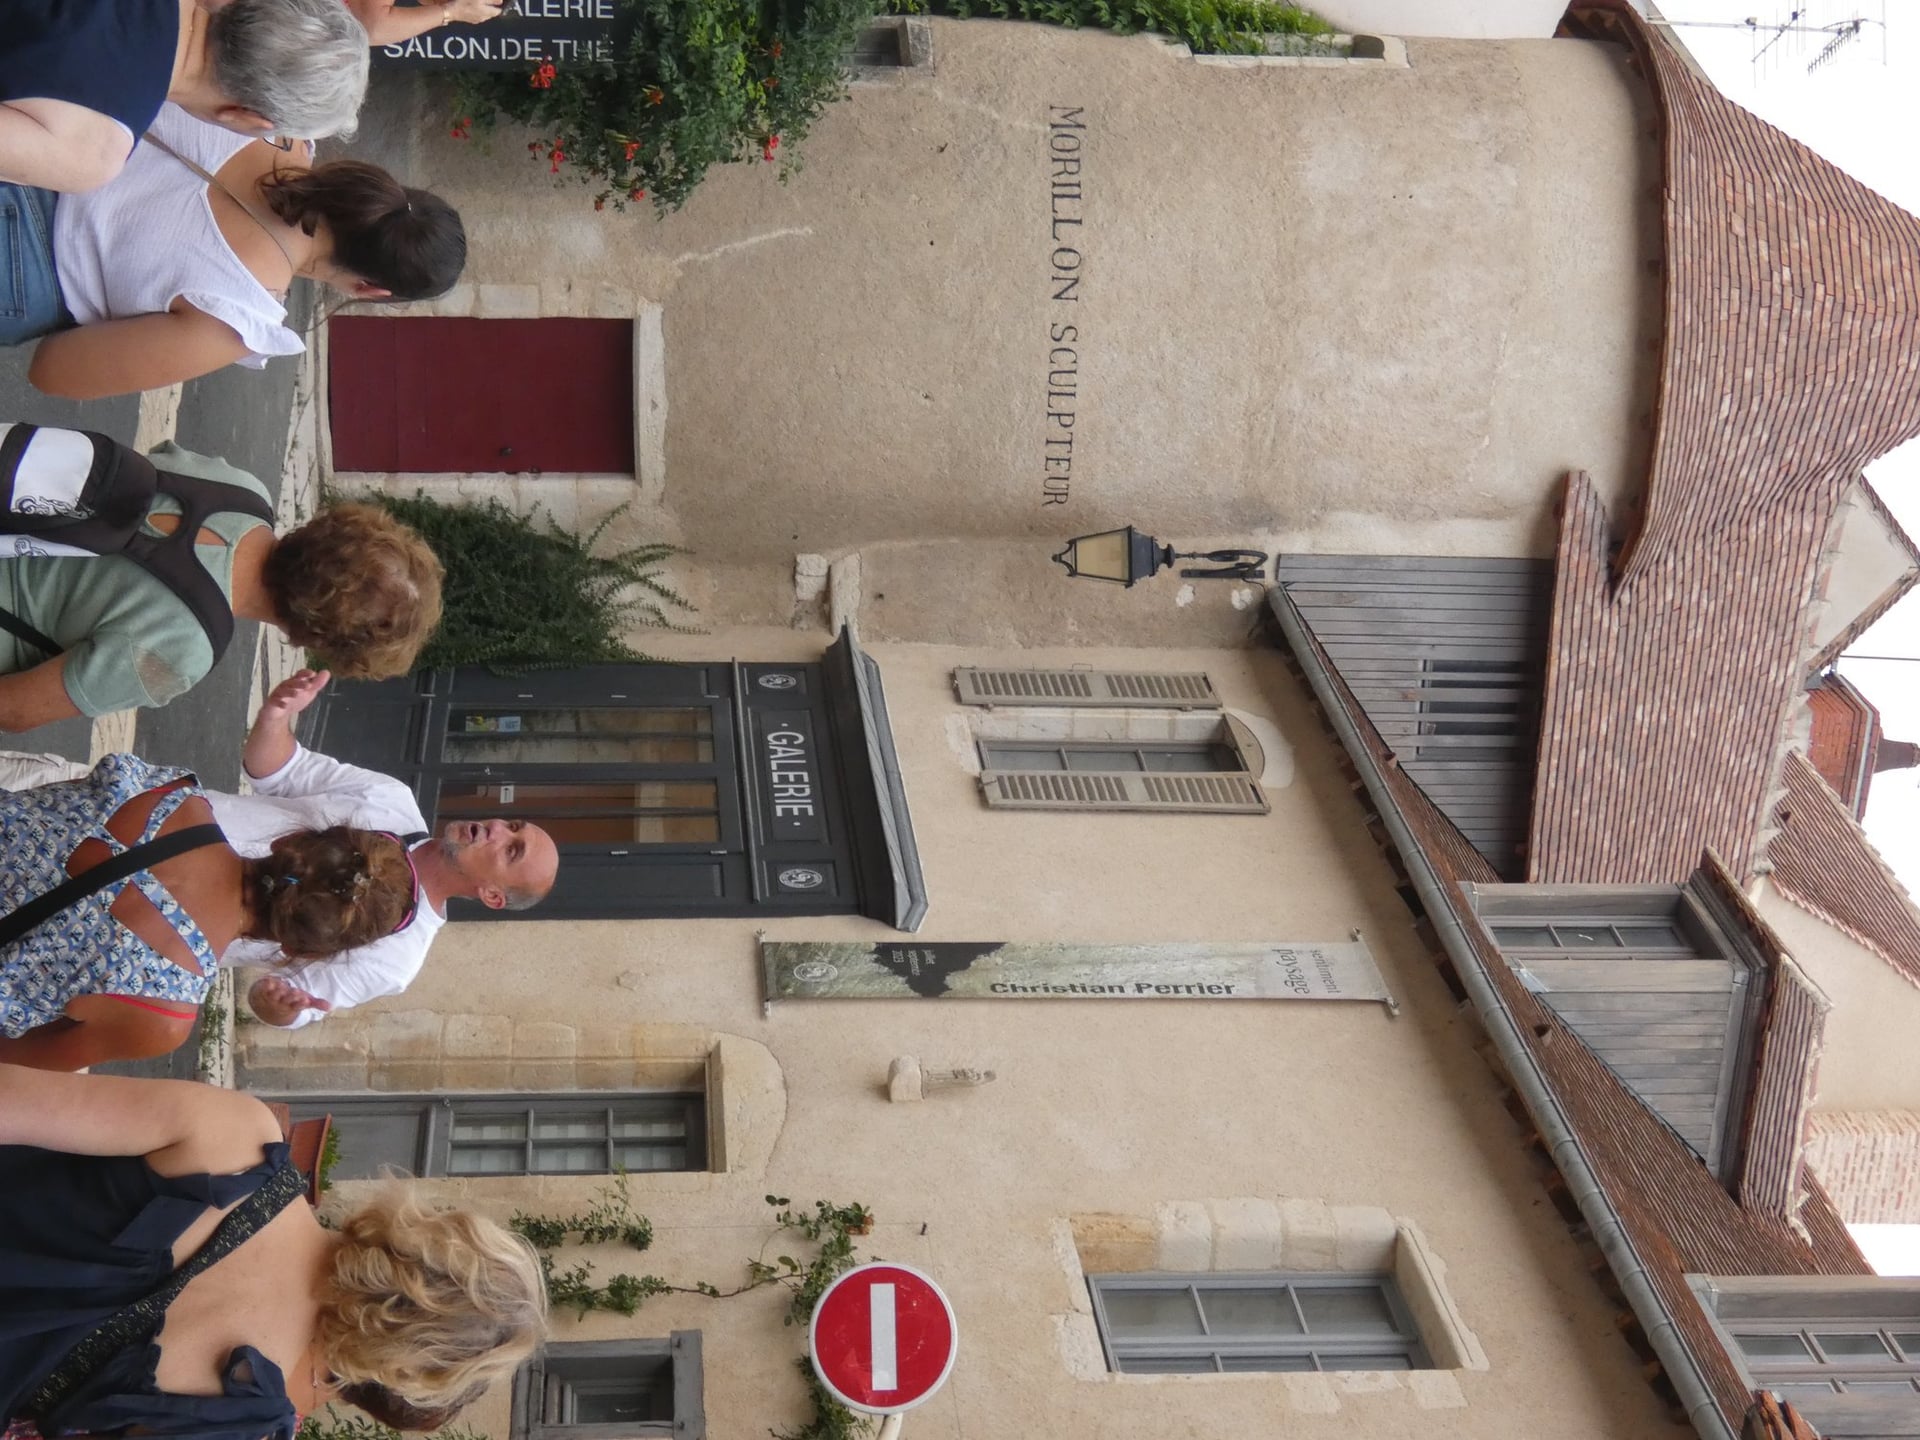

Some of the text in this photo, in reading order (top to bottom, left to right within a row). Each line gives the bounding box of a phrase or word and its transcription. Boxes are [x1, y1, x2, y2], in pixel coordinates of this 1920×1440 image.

[503, 0, 614, 18] ALERIE
[1042, 105, 1086, 507] MORILLON SCULPTEUR
[767, 731, 814, 817] GALERIE
[989, 982, 1236, 995] Christian Perrier
[1272, 949, 1311, 994] paysage
[1311, 949, 1342, 994] sentiment
